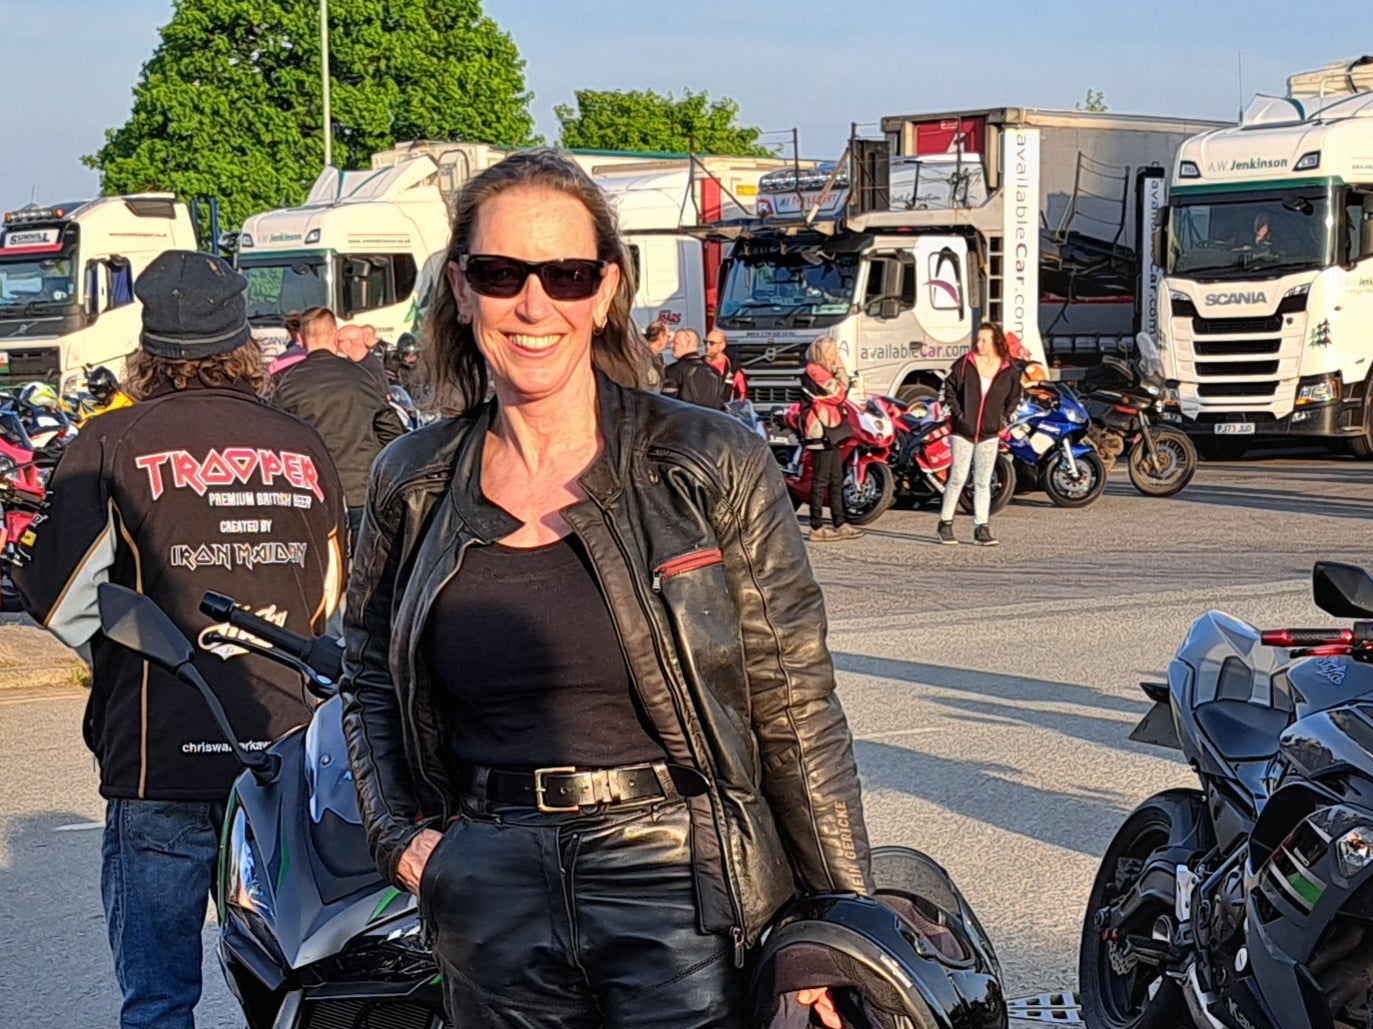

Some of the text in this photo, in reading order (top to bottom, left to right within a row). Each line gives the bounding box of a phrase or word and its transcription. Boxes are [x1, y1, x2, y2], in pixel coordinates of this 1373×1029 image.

[1230, 157, 1288, 172] Jenkinson
[1205, 291, 1268, 306] SCANIA
[861, 342, 970, 360] availableCar.com
[135, 448, 325, 502] TROOPER
[209, 493, 254, 507] PREMIUM
[257, 493, 291, 508] BRITISH
[220, 519, 272, 533] CREATED BY
[171, 543, 232, 571] IRON
[835, 802, 857, 859] GERICKE
